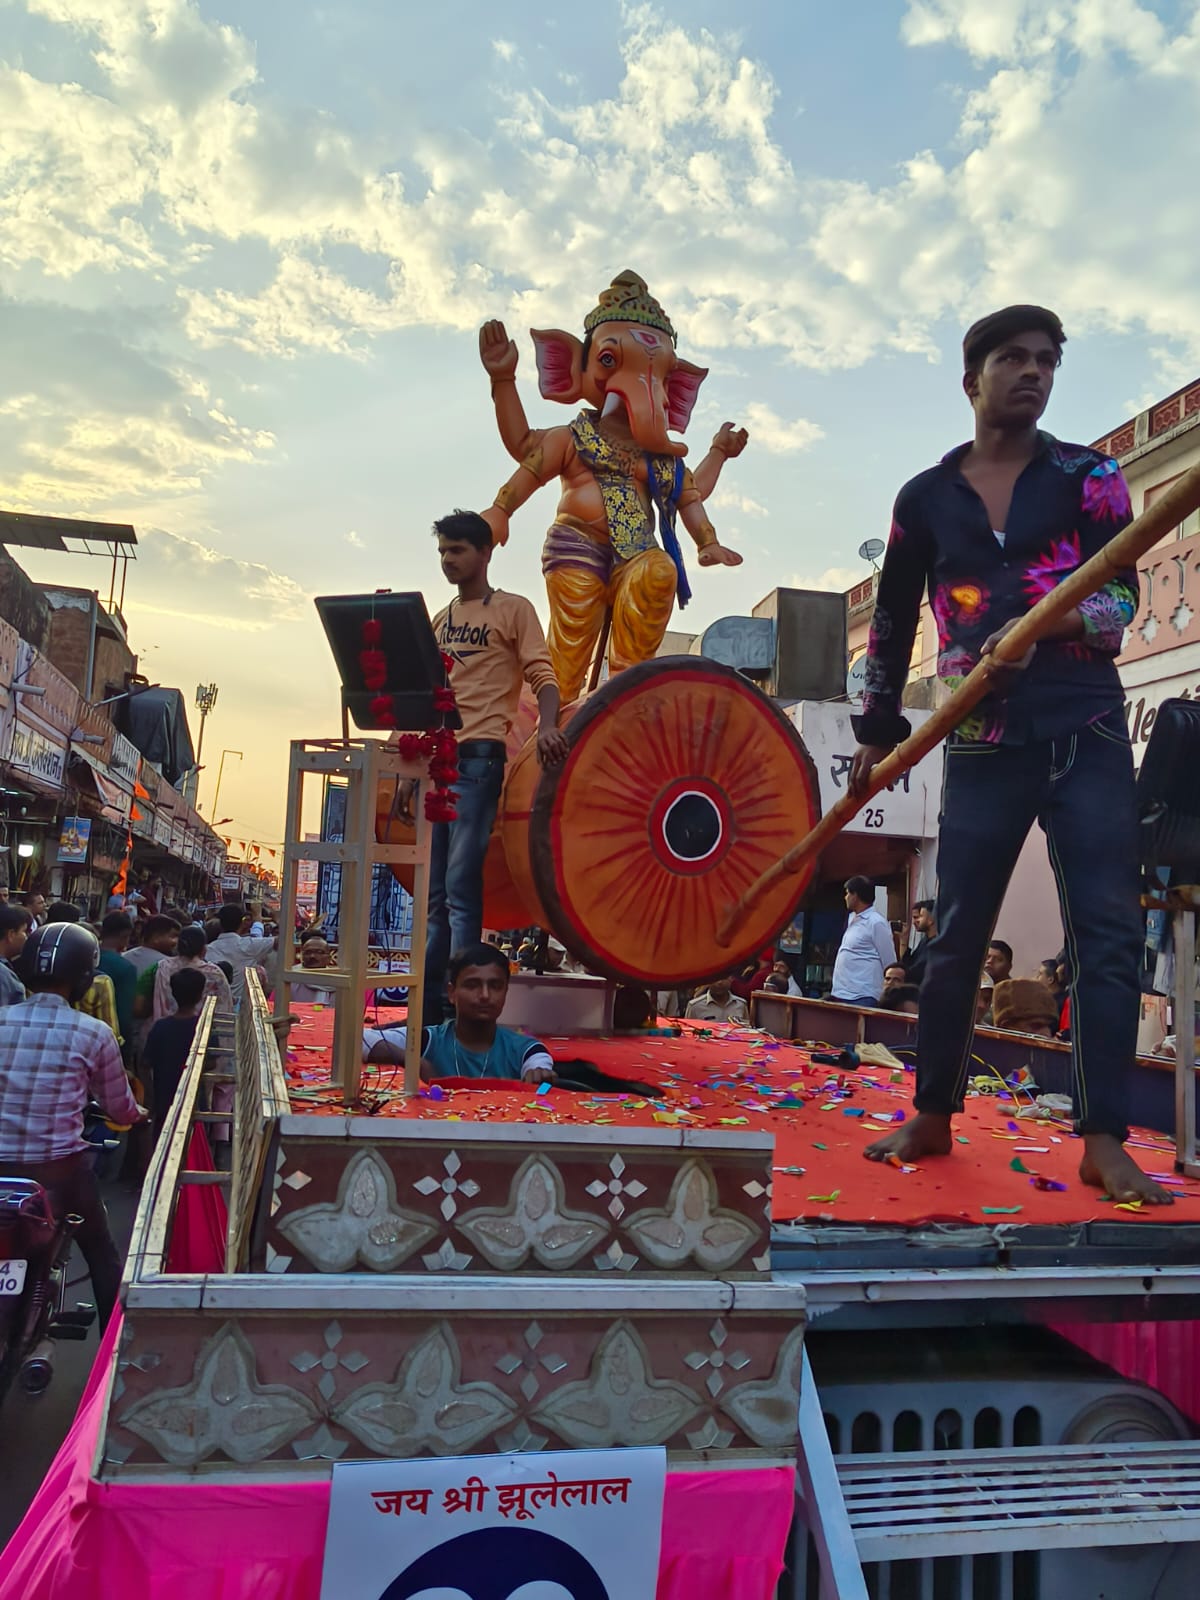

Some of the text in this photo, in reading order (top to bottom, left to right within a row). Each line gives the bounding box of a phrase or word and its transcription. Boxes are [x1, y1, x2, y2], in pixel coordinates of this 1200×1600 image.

[865, 808, 885, 828] 25
[371, 1471, 632, 1520] जय श्री झूलेलाल
